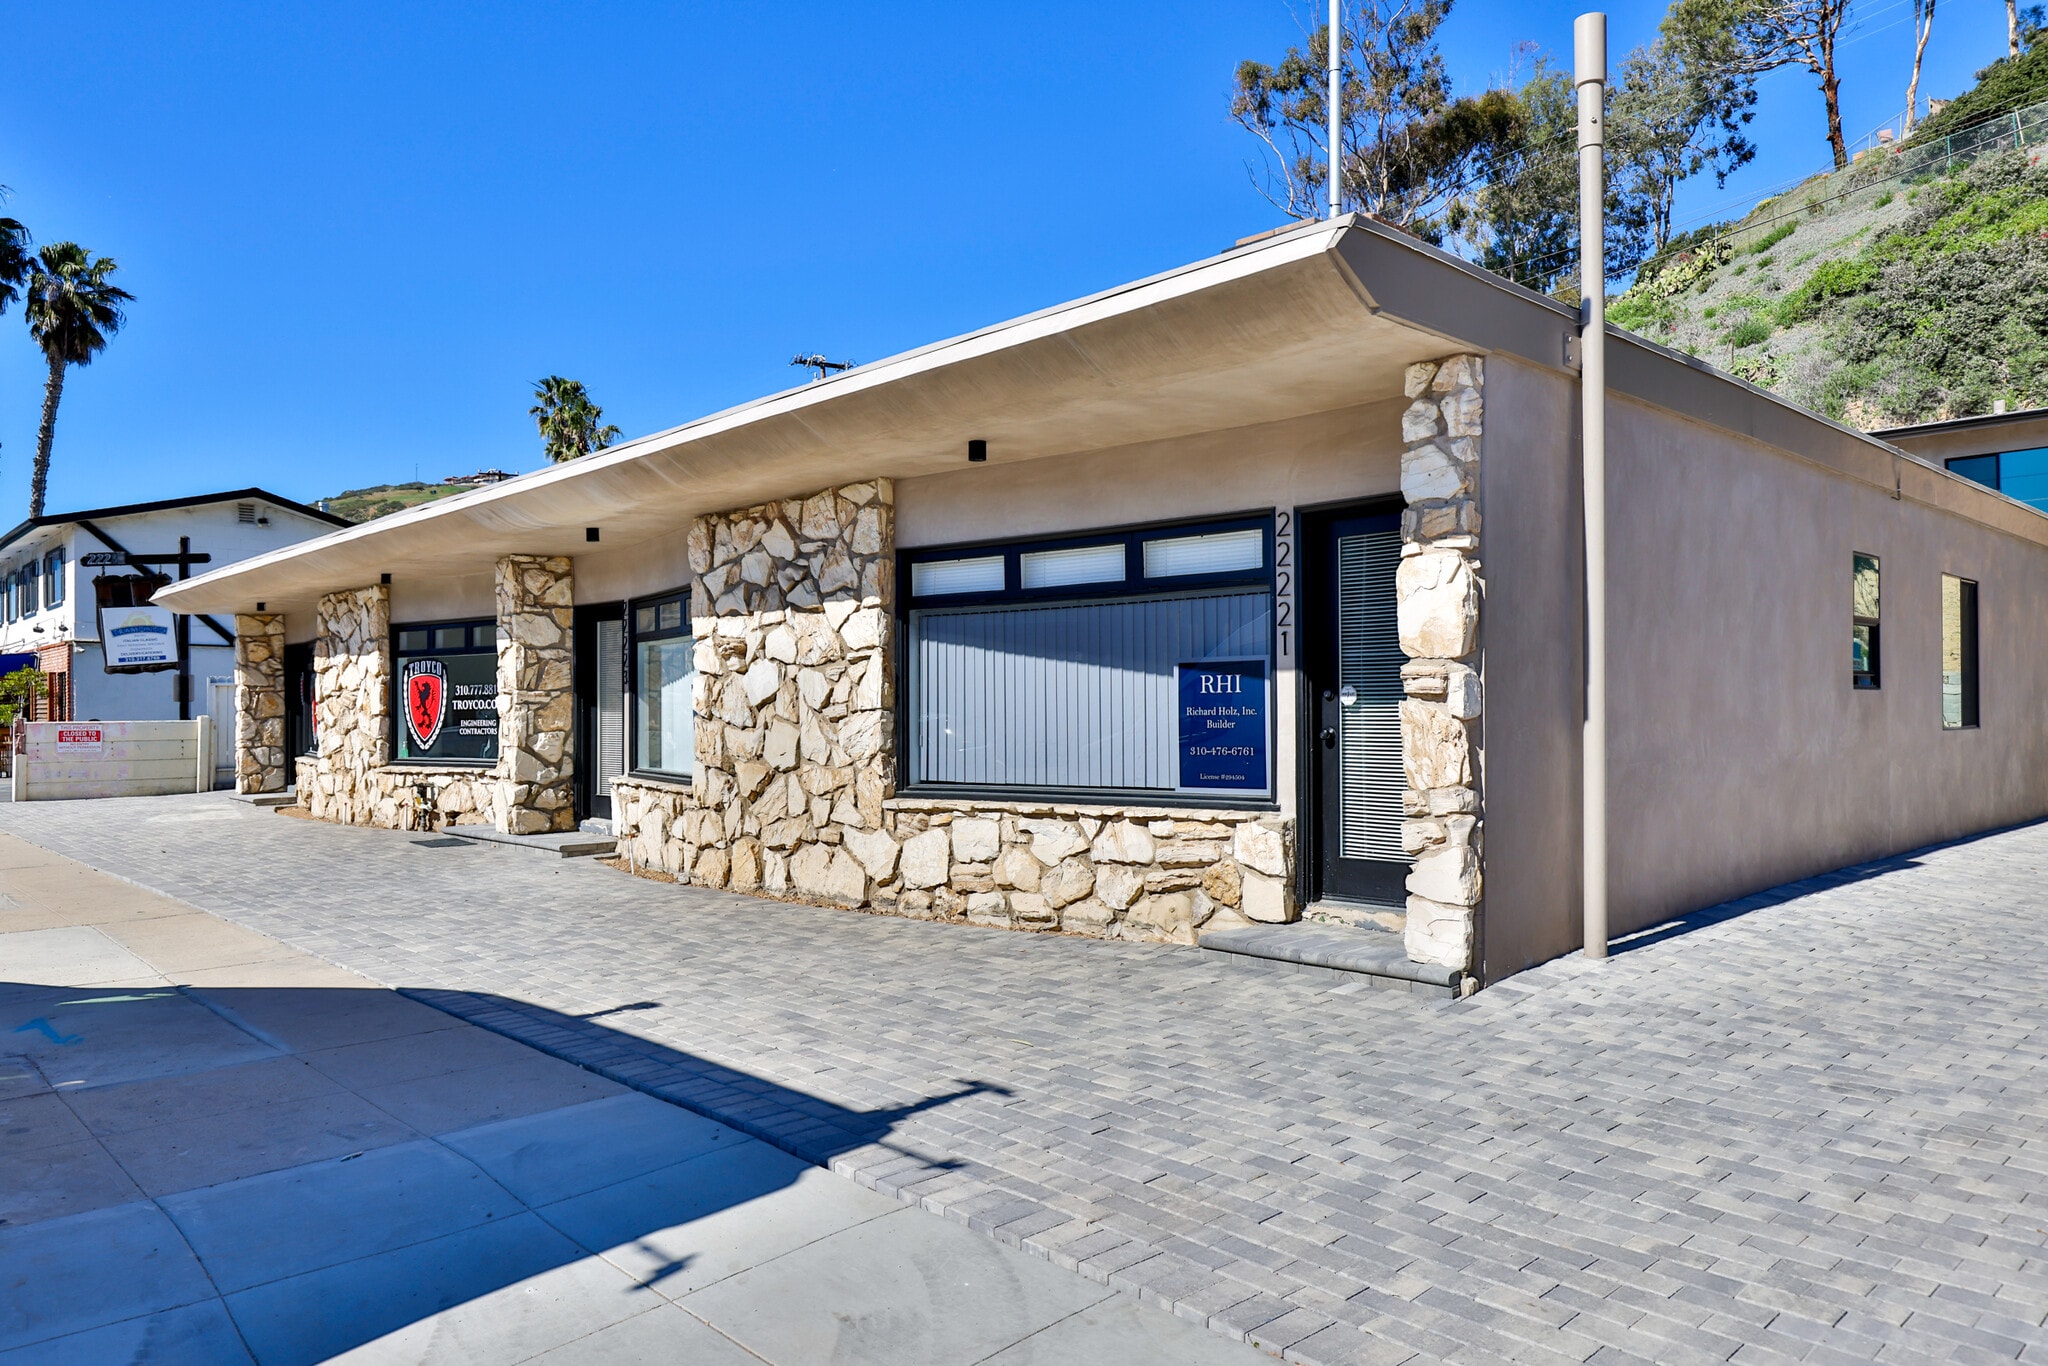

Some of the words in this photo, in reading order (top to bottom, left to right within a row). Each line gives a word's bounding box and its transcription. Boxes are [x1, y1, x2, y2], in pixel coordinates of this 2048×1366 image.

[1276, 511, 1291, 656] 22221
[408, 660, 442, 676] TROYCO
[1200, 674, 1241, 694] RHI
[1186, 706, 1216, 716] Richard
[1218, 706, 1240, 717] Holz,
[1242, 706, 1258, 716] Inc.
[460, 719, 497, 727] ENGINEERING
[1207, 719, 1236, 729] Builder
[459, 727, 498, 735] CONTRACTORS
[1189, 746, 1254, 756] 310-476-6761
[1200, 772, 1220, 780] License
